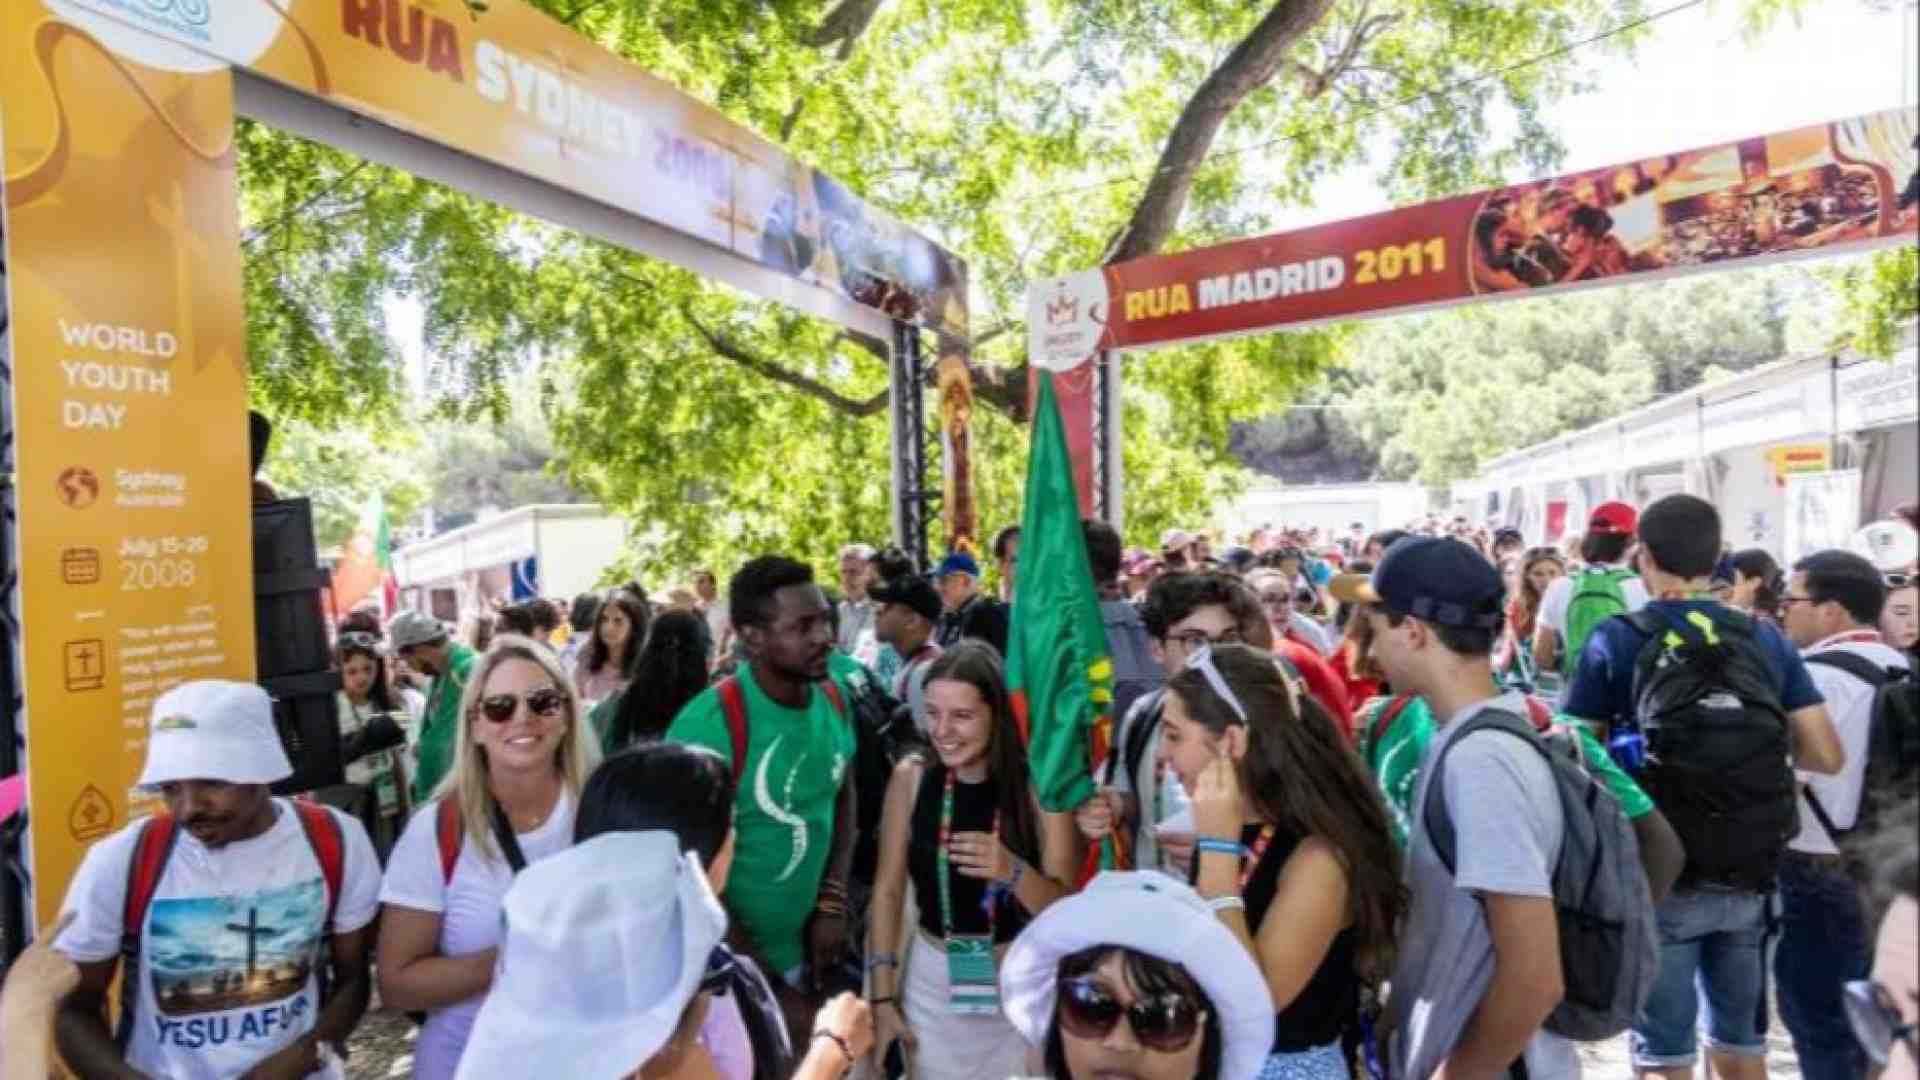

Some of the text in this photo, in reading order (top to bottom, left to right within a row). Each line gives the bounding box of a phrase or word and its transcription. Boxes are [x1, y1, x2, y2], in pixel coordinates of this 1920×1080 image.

[340, 0, 464, 84] RUA
[474, 38, 640, 160] SYDNEY
[1124, 237, 1446, 322] RUA MADRID 2011
[57, 318, 177, 359] WORLD
[60, 360, 171, 396] YOUTH
[62, 400, 128, 430] DAY
[119, 558, 194, 592] 2008
[156, 1015, 230, 1049] YESU
